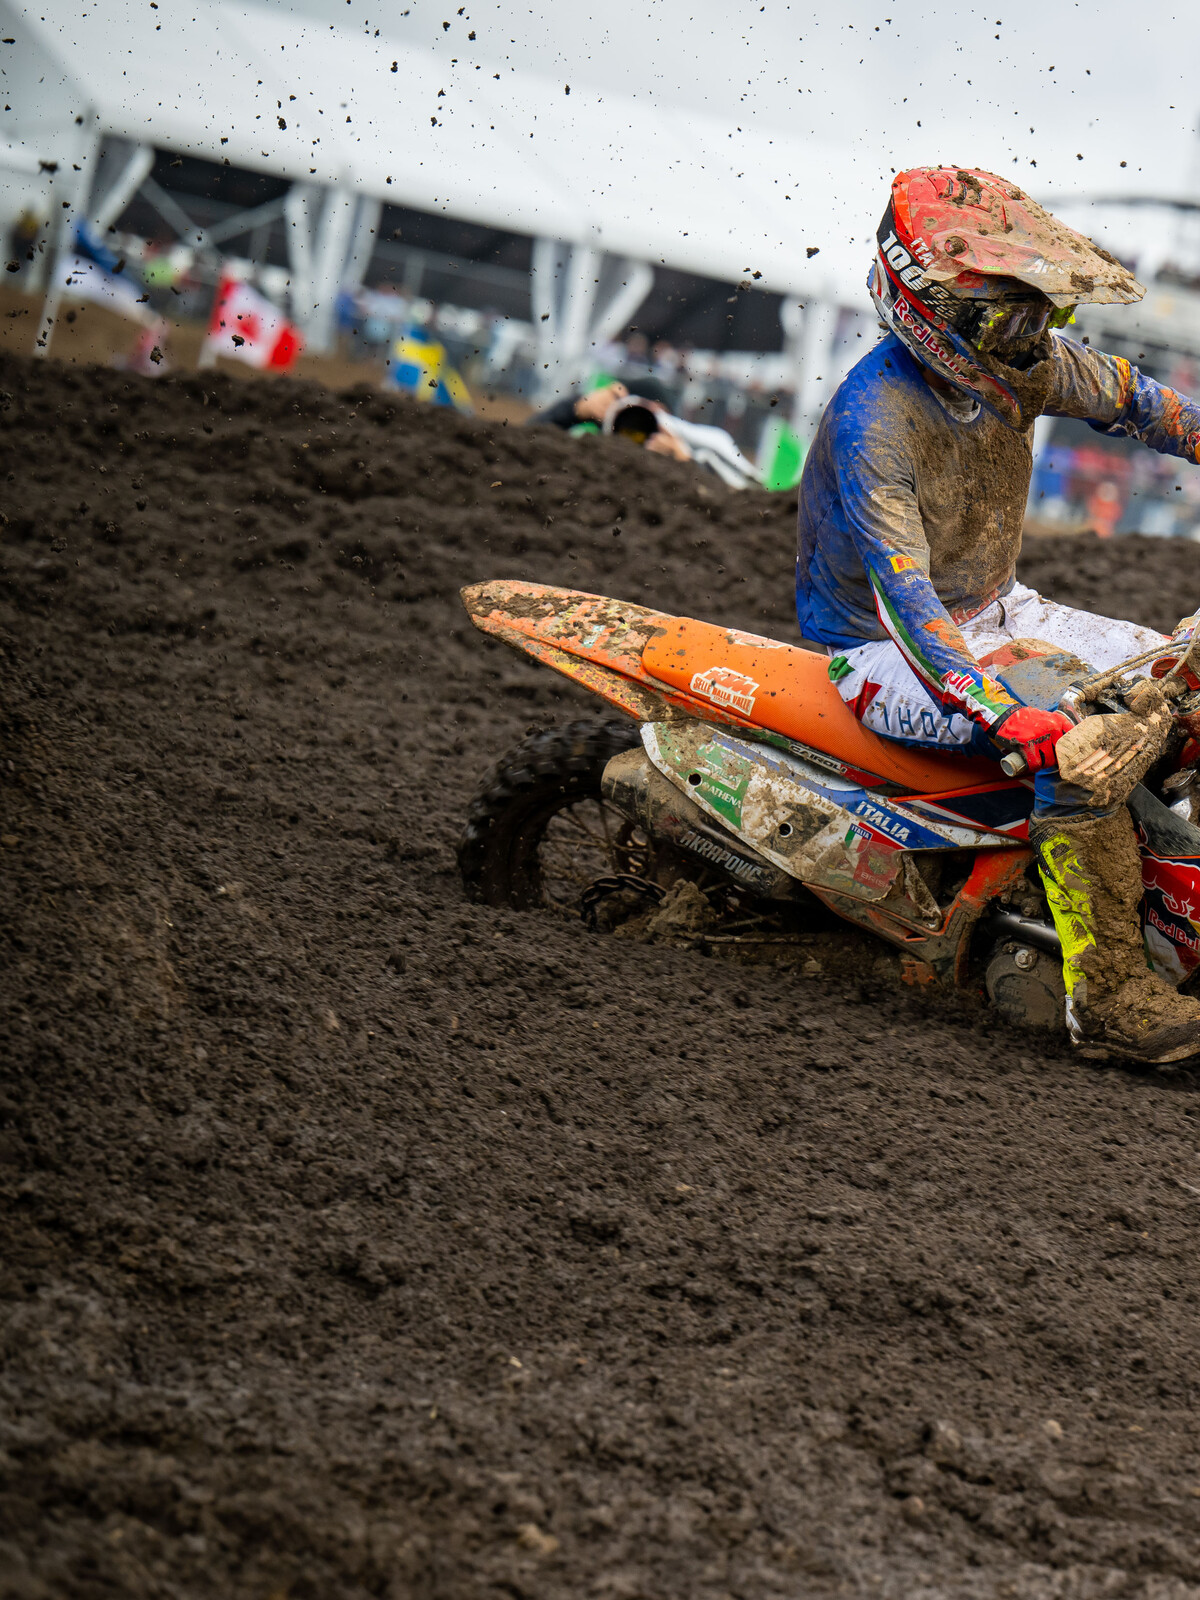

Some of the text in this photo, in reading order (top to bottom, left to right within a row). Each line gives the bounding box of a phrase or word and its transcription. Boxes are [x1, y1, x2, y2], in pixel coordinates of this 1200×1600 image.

[881, 230, 957, 318] 100%
[893, 296, 931, 342] Red
[789, 745, 847, 774] CAIROLI
[709, 786, 742, 807] ATHENA
[851, 825, 870, 839] ITALIA
[855, 801, 911, 842] ITALIA
[1148, 908, 1175, 938] Red
